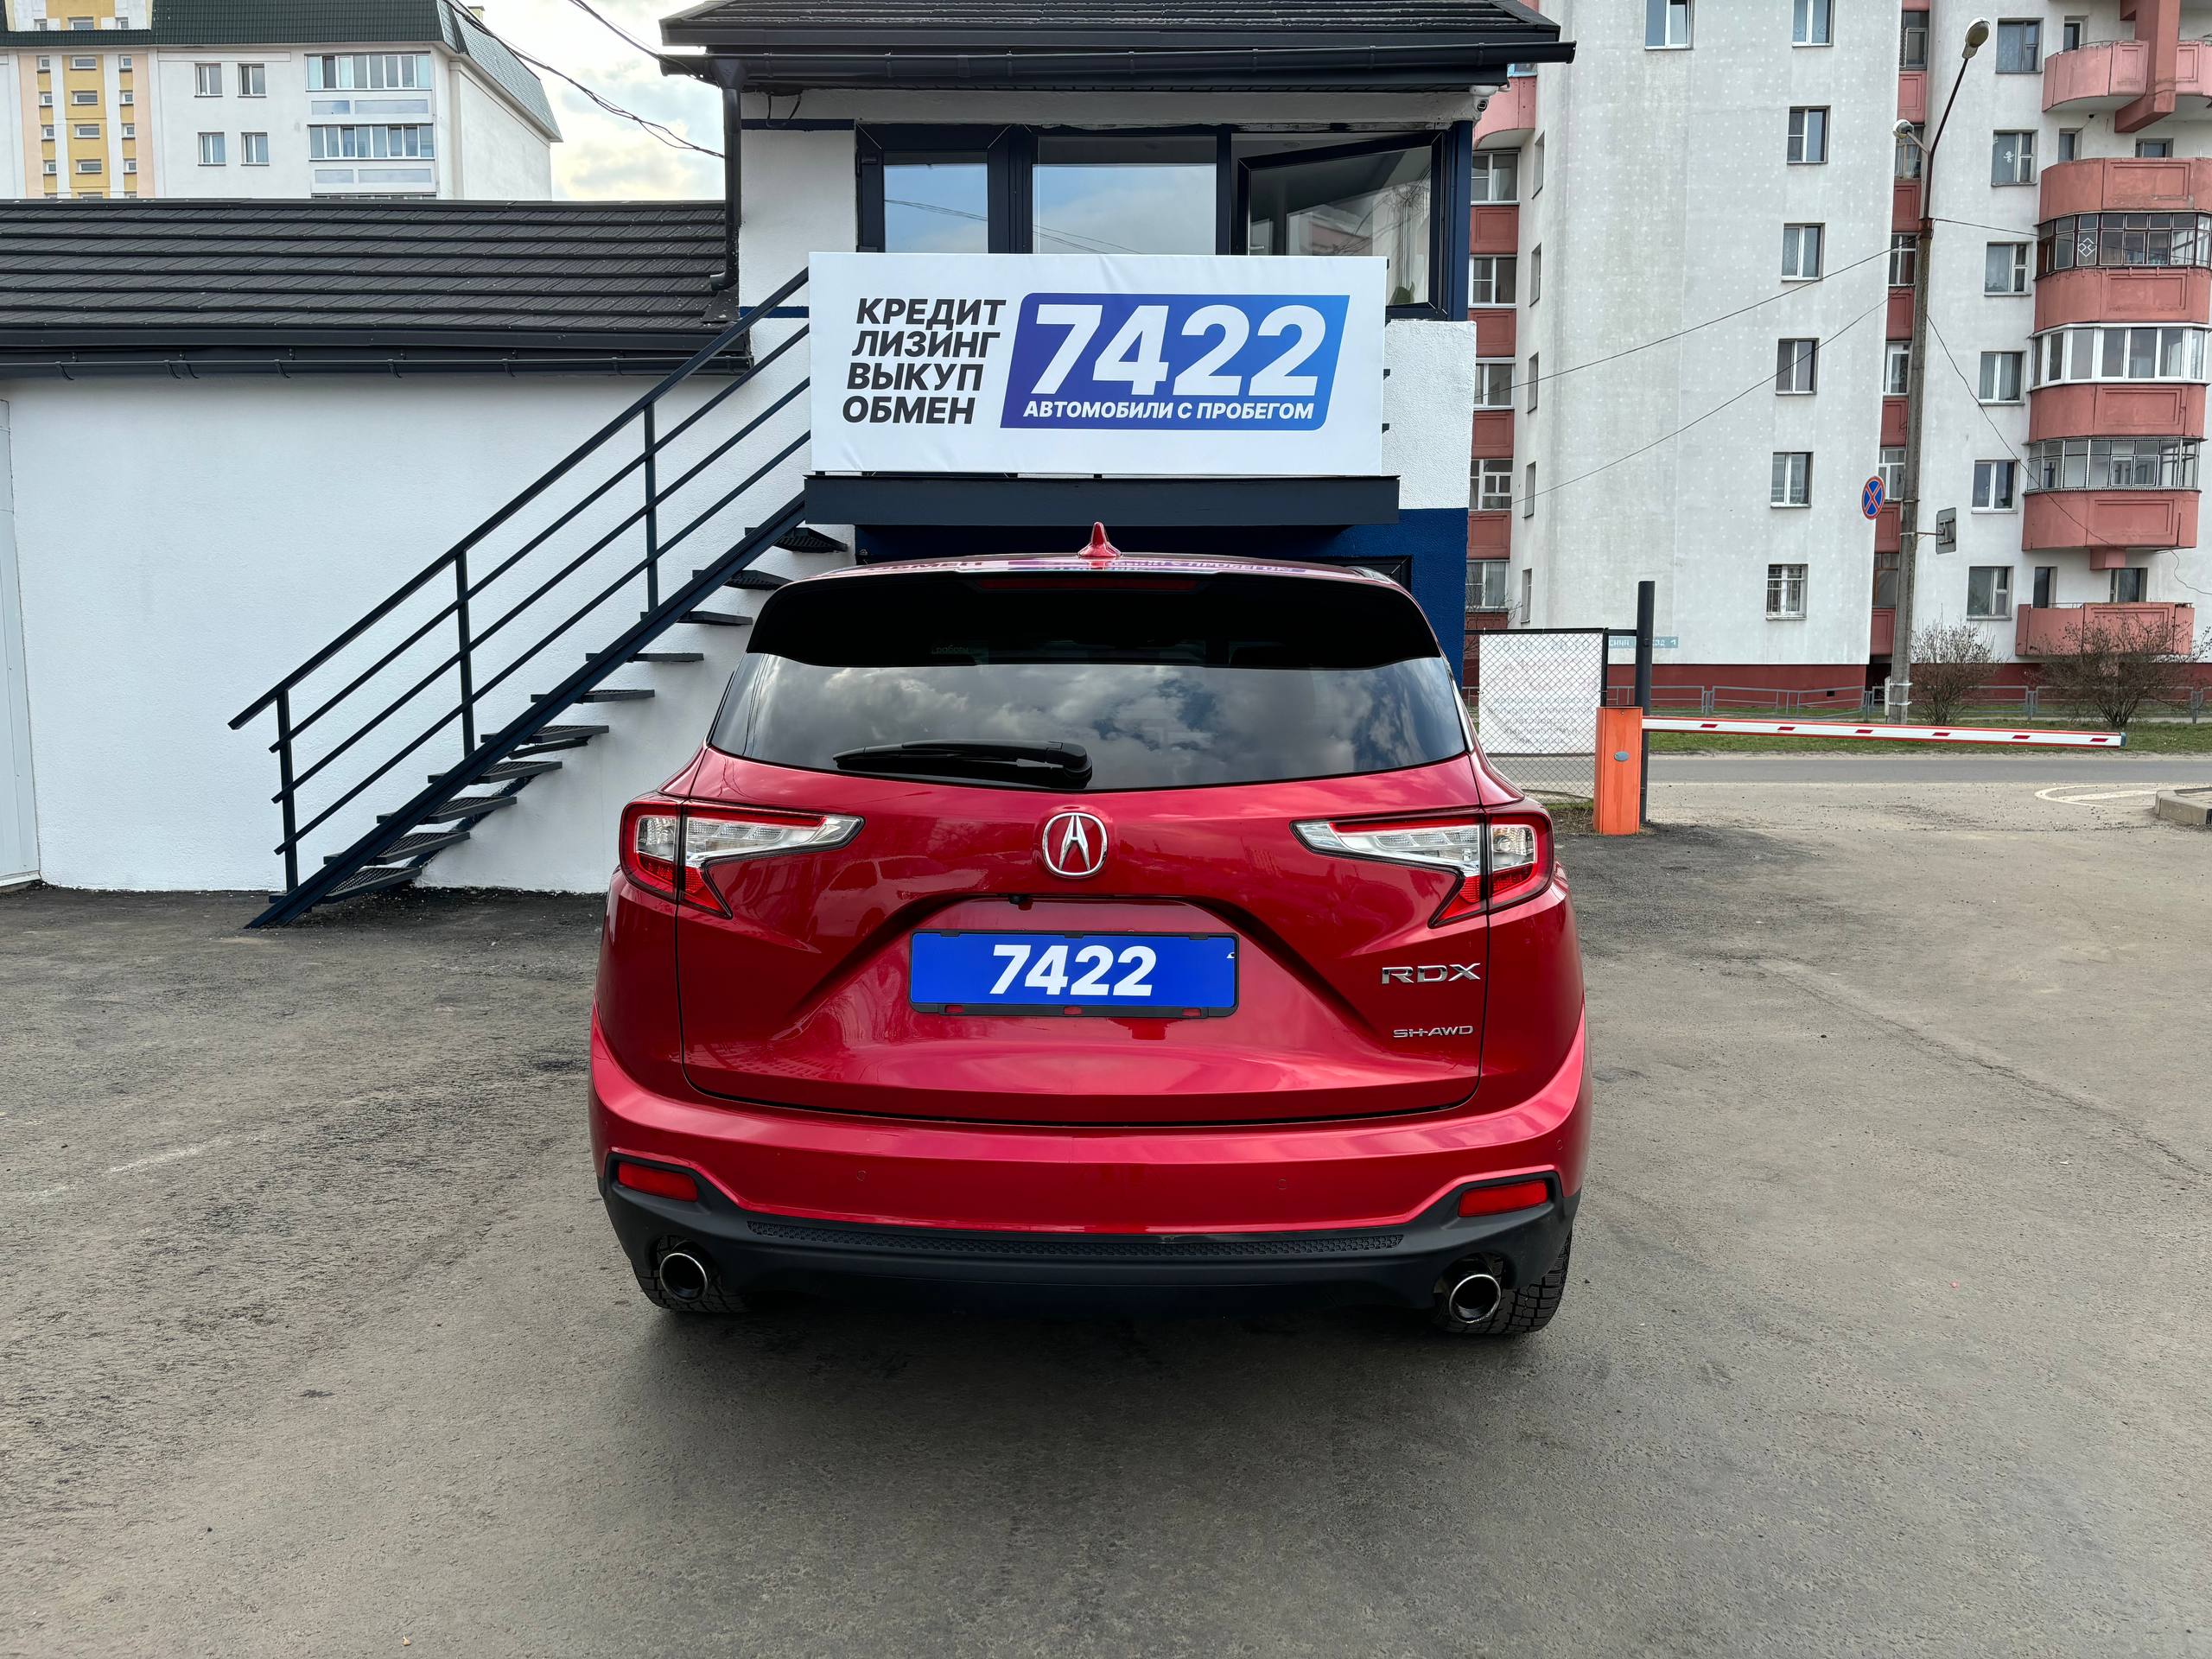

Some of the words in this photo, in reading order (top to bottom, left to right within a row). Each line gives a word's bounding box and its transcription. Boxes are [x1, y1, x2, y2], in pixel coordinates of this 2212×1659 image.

[855, 297, 1007, 331] КРЕДИТ
[851, 330, 1001, 359] ЛИЗИНГ
[1030, 303, 1326, 397] 7422
[846, 362, 984, 391] ВЫКУП
[842, 395, 976, 425] ОБМЕН
[1022, 400, 1174, 419] АВТОМОБИЛИ
[1177, 402, 1192, 419] С
[1196, 402, 1314, 420] ПРОБЕГОМ
[989, 944, 1157, 996] 7422
[1382, 963, 1482, 984] RDX
[1393, 1025, 1474, 1038] SH-AWD
